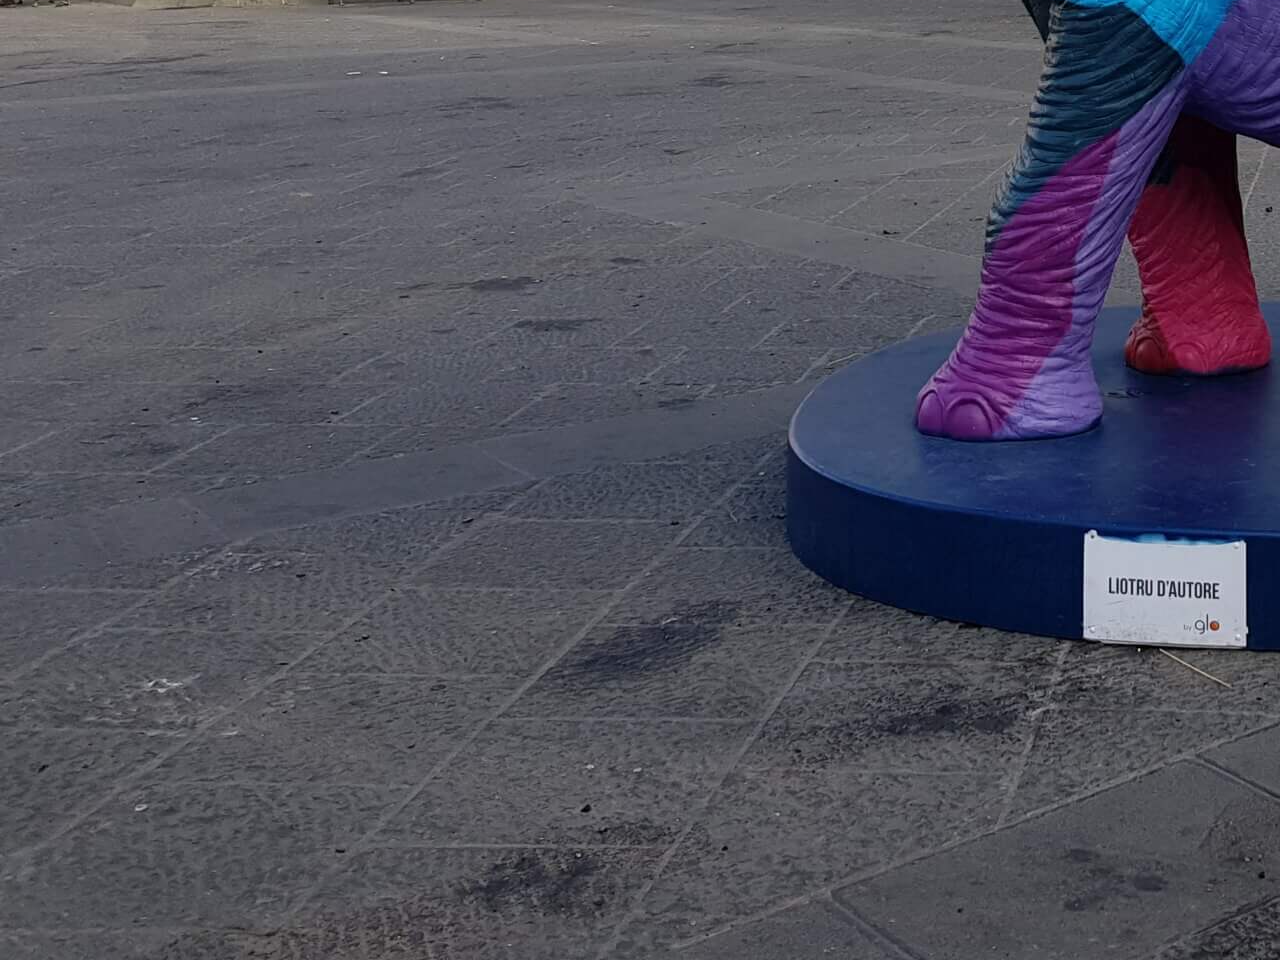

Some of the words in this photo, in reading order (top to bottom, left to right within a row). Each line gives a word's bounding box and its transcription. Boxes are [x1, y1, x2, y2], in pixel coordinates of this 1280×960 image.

[1108, 576, 1153, 597] LIOTRU
[1156, 579, 1220, 600] D'AUTORE
[1194, 613, 1220, 635] glo
